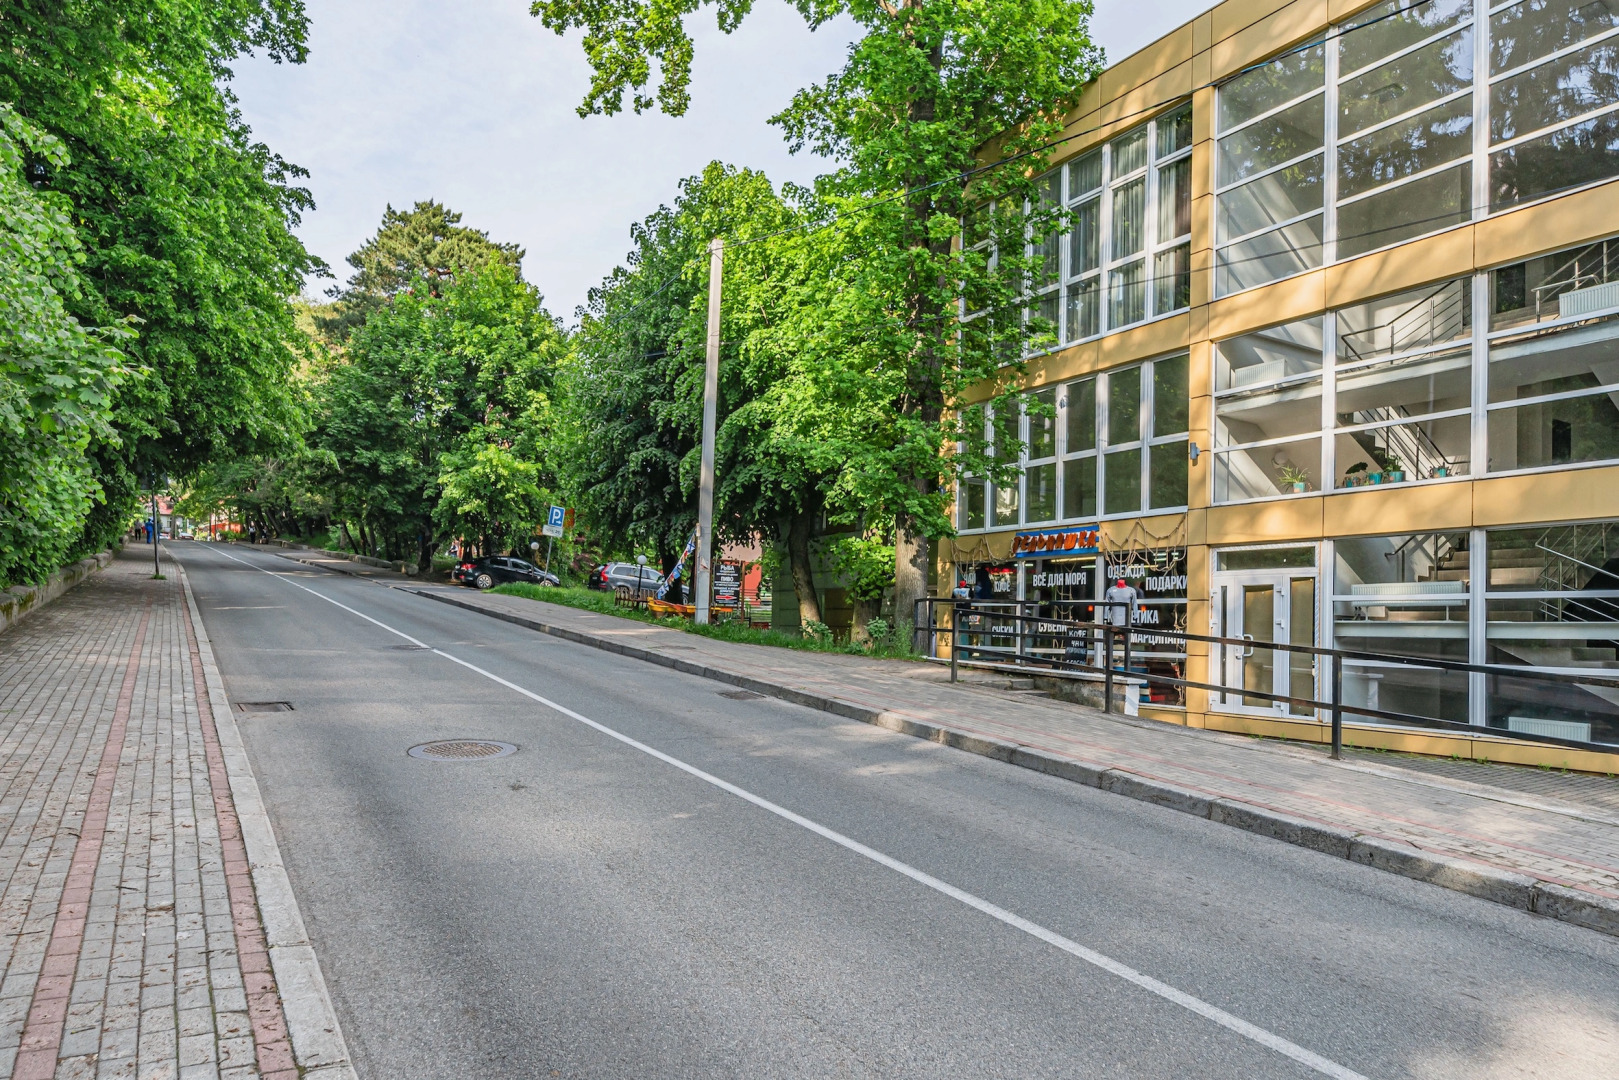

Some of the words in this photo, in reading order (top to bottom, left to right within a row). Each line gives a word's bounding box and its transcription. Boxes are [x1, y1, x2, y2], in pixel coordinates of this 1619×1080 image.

[552, 508, 561, 524] P
[1012, 530, 1097, 554] ТЕЛЬНЯШКА
[1107, 564, 1145, 579] ОДЕЖДА
[993, 581, 1010, 593] КОФЕ
[1033, 572, 1046, 587] ВСЁ
[1048, 573, 1063, 587] ДЛЯ
[1065, 572, 1087, 586] МОРЯ
[1146, 575, 1188, 592] ПОДАРКИ
[1107, 610, 1159, 624] КЕТИКА
